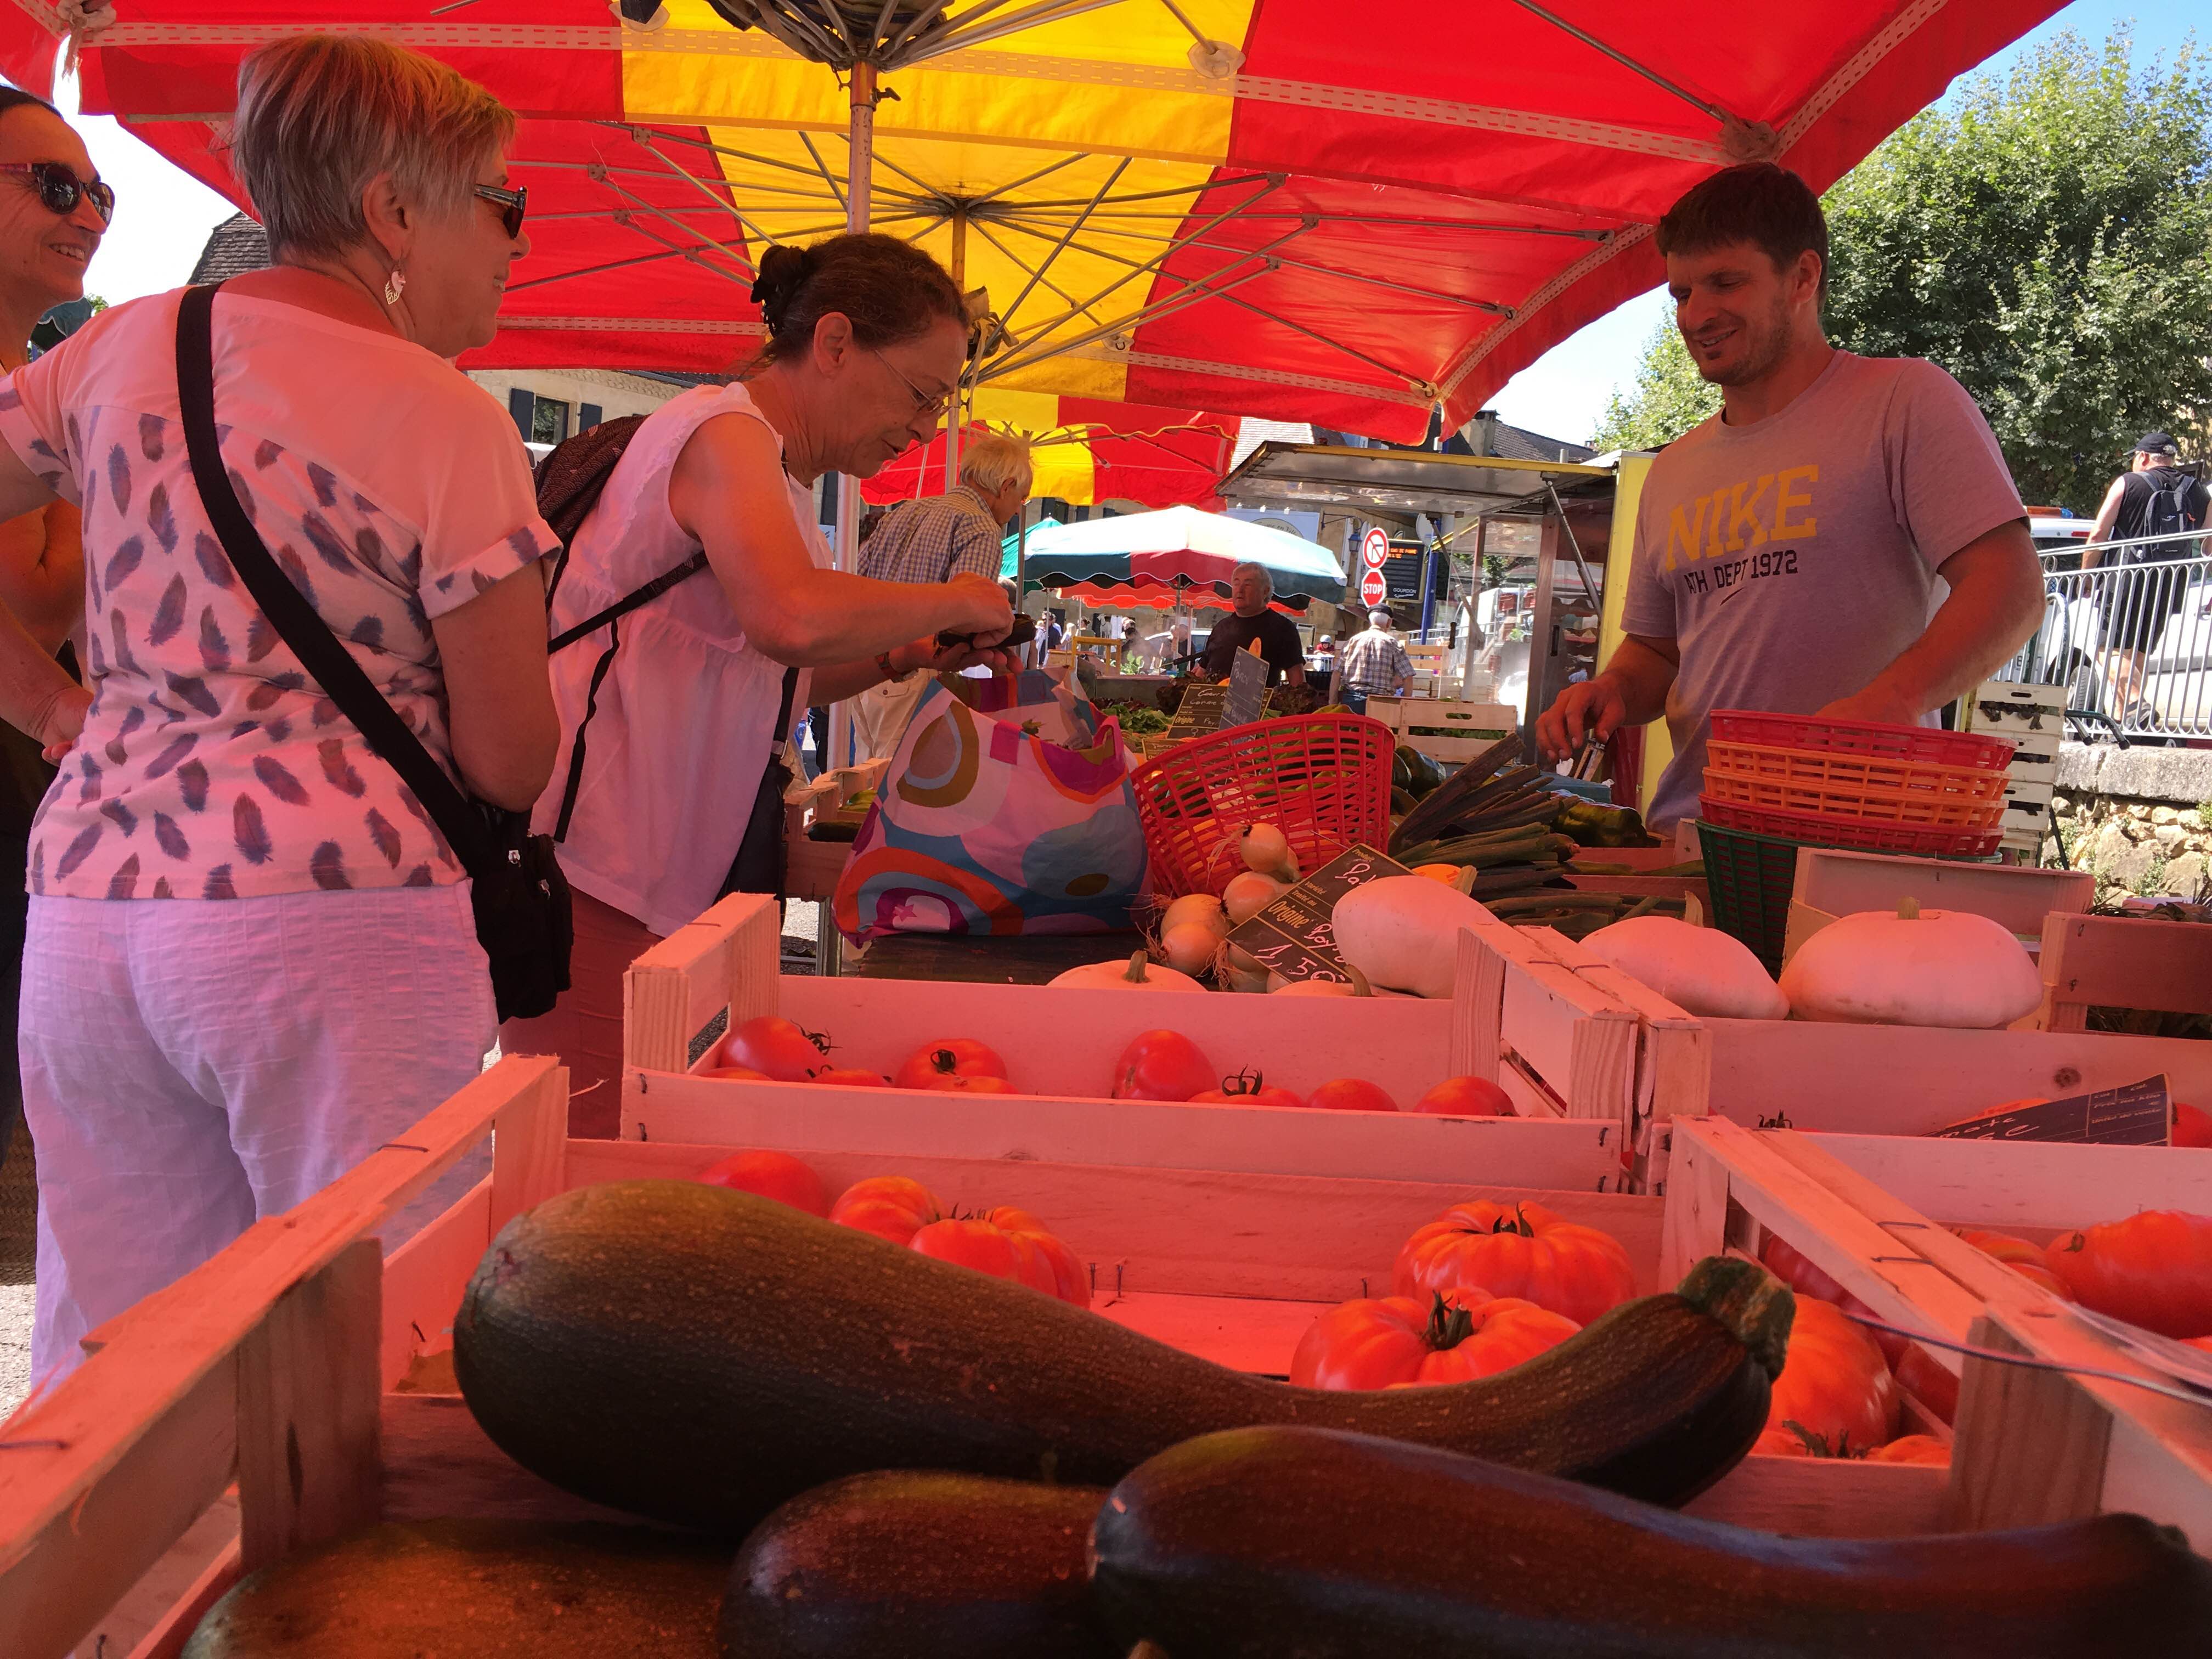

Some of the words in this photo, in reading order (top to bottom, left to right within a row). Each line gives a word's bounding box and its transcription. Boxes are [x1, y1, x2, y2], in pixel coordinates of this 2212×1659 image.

[1666, 465, 1819, 572] NIKE
[1684, 570, 1708, 594] ATH
[1714, 558, 1748, 589] DEPT
[1751, 550, 1798, 579] 1972
[1364, 584, 1383, 595] STOP
[1352, 849, 1375, 862] Produit
[1291, 890, 1312, 902] Traité
[1268, 901, 1310, 928] Origine
